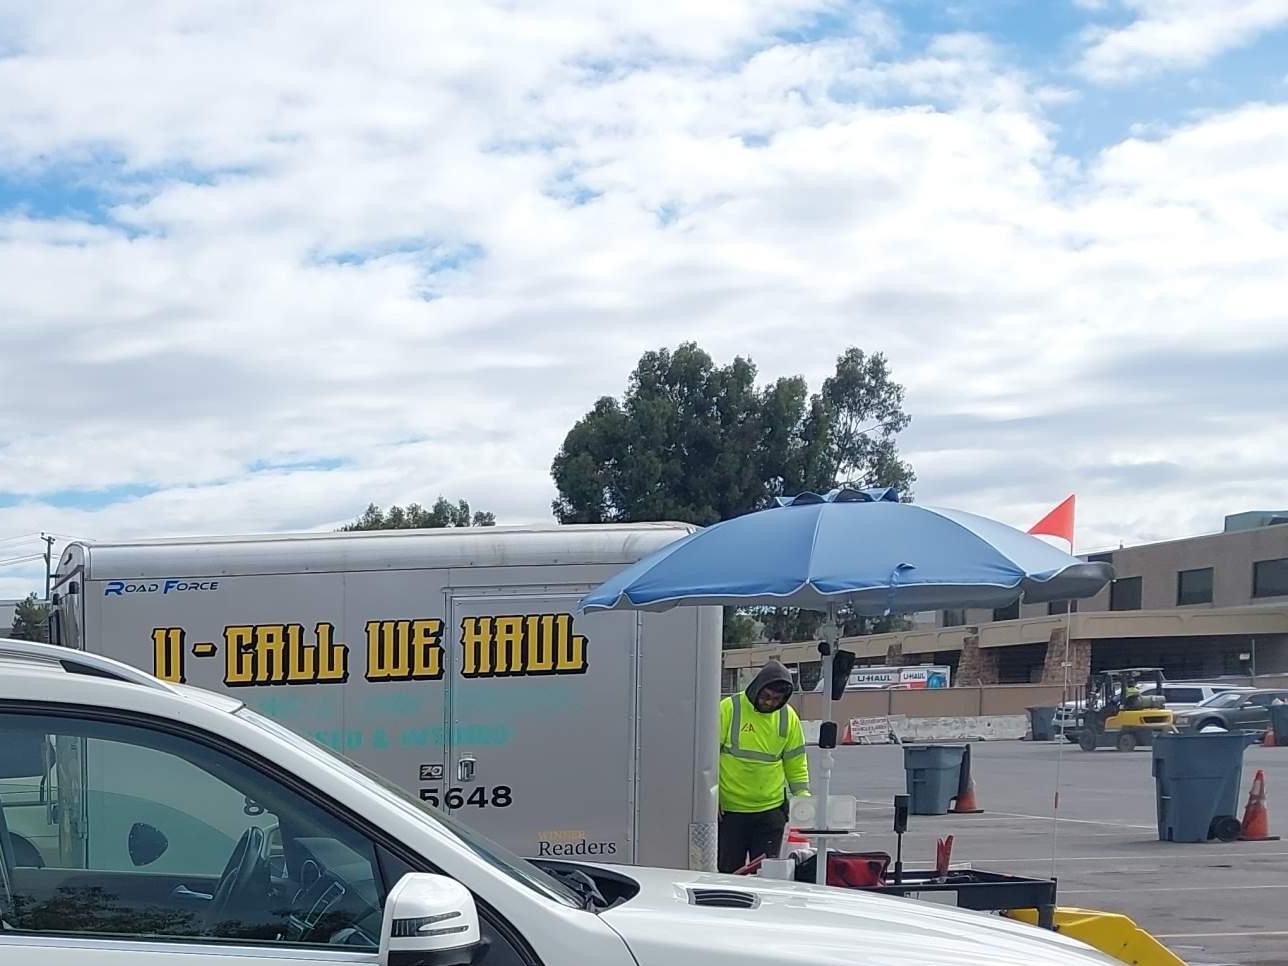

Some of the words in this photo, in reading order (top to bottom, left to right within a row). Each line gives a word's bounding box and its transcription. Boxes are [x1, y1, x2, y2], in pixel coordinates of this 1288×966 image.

[152, 627, 186, 684] U
[223, 622, 349, 688] CALL
[365, 618, 445, 683] WE
[461, 613, 589, 678] HAUL
[419, 785, 513, 810] 5648
[538, 840, 617, 857] Readers
